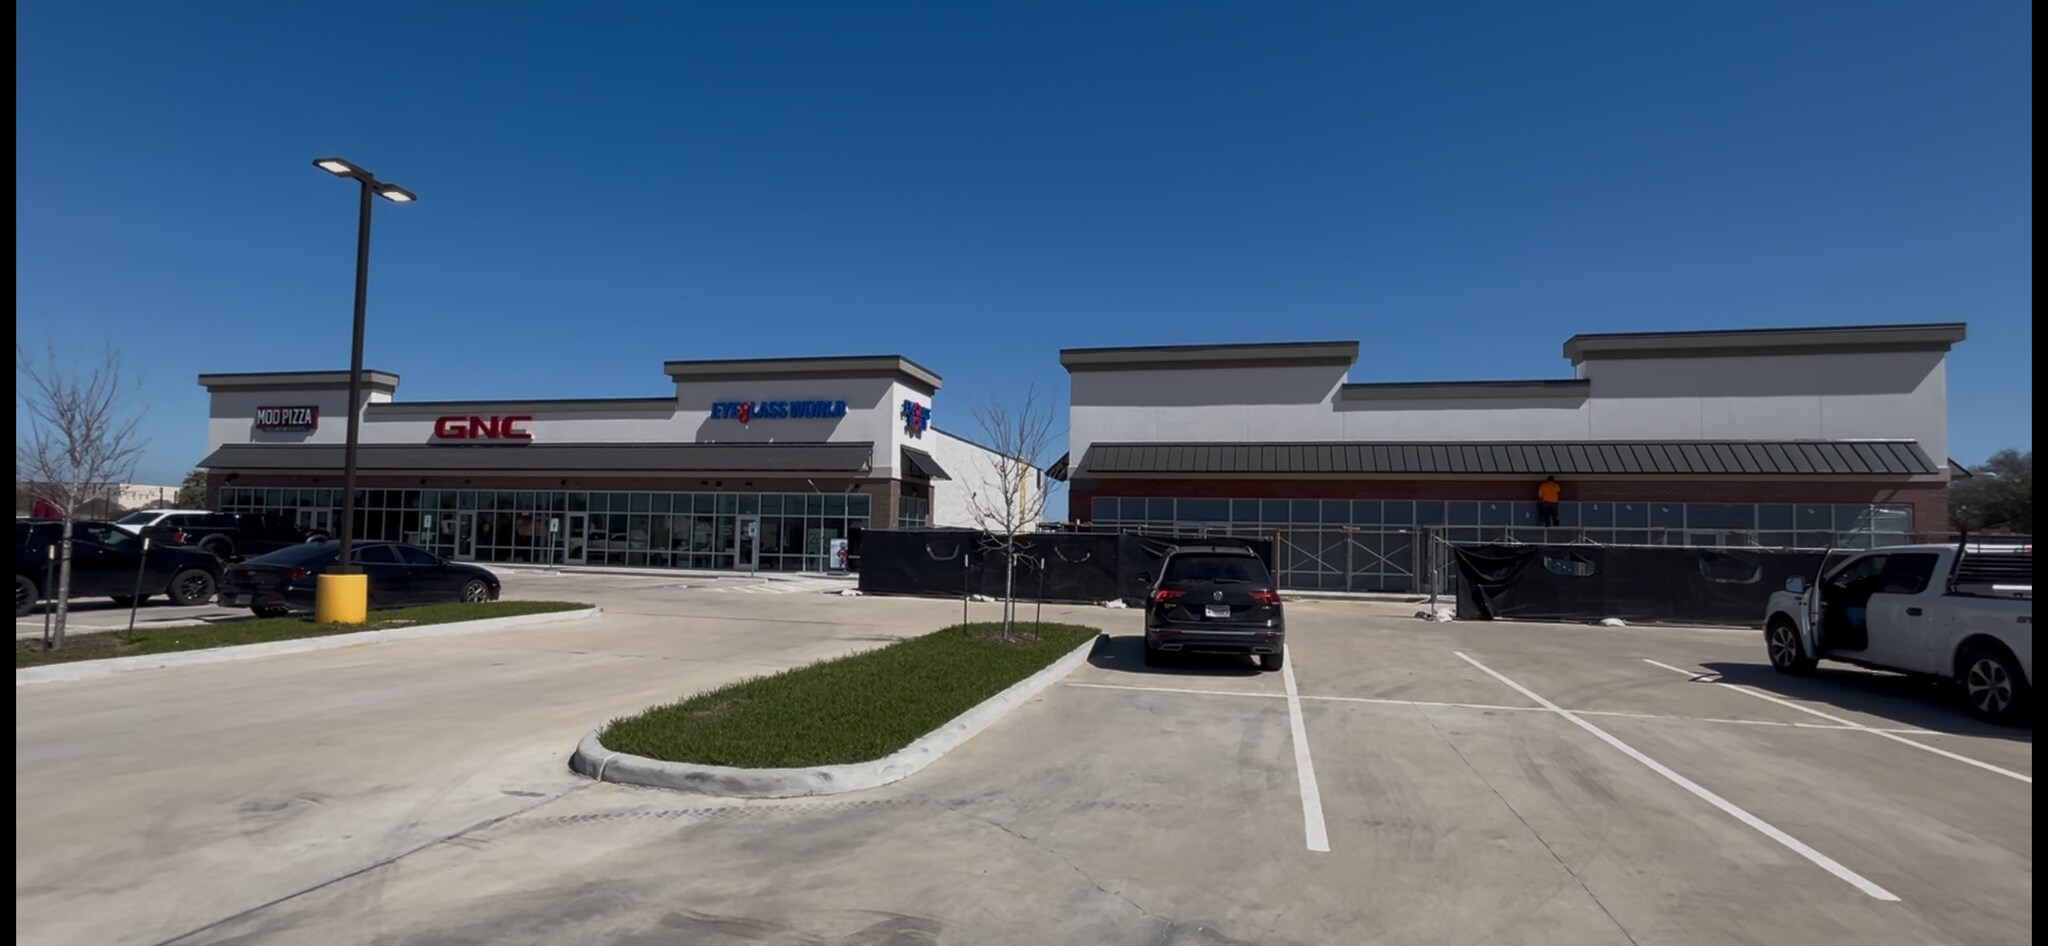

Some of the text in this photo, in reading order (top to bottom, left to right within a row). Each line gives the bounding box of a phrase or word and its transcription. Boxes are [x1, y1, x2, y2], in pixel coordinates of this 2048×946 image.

[257, 408, 311, 425] MOD PIZZA
[789, 400, 847, 419] WORLD
[434, 416, 532, 439] GNC
